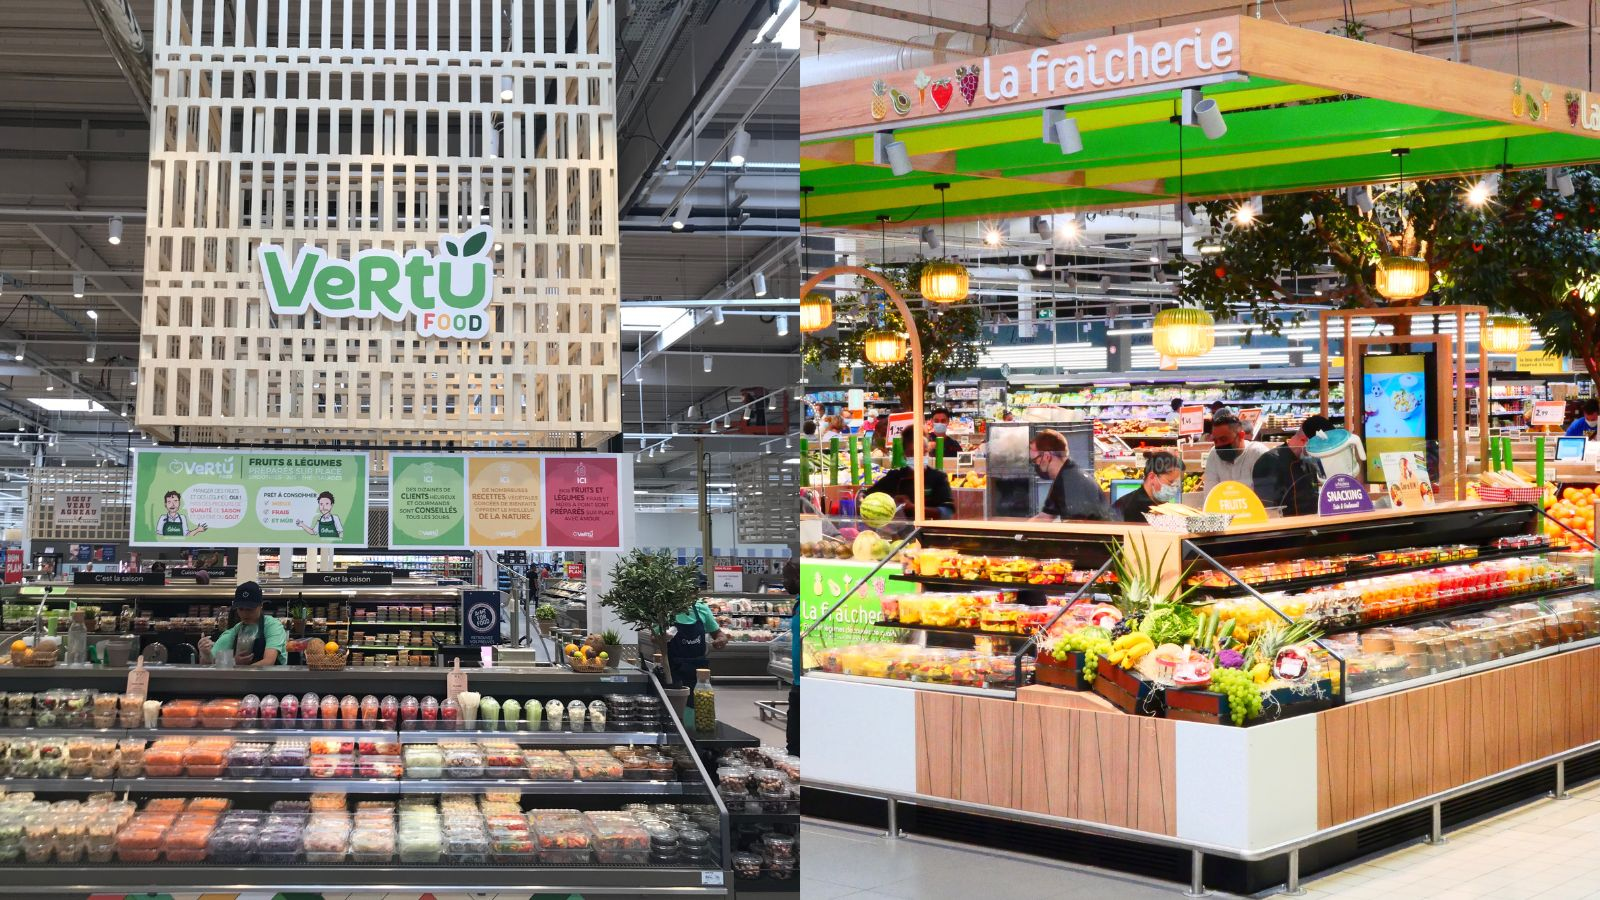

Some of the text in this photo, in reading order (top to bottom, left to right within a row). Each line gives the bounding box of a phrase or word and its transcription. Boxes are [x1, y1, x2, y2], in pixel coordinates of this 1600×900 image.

[983, 28, 1233, 101] la fraîcherie
[423, 312, 482, 332] FOOD
[249, 457, 343, 467] FRUITS & LÉGUMES
[1326, 489, 1363, 503] SNACKING
[1219, 498, 1249, 510] FRUITS
[414, 505, 458, 514] CONSEILLÉS
[550, 507, 585, 515] PRÉPARÉS
[7, 553, 20, 562] BON
[6, 563, 21, 573] PLAN
[114, 574, 120, 582] la
[323, 575, 341, 583] C'est
[349, 575, 371, 583] saison
[476, 618, 490, 627] FOOD
